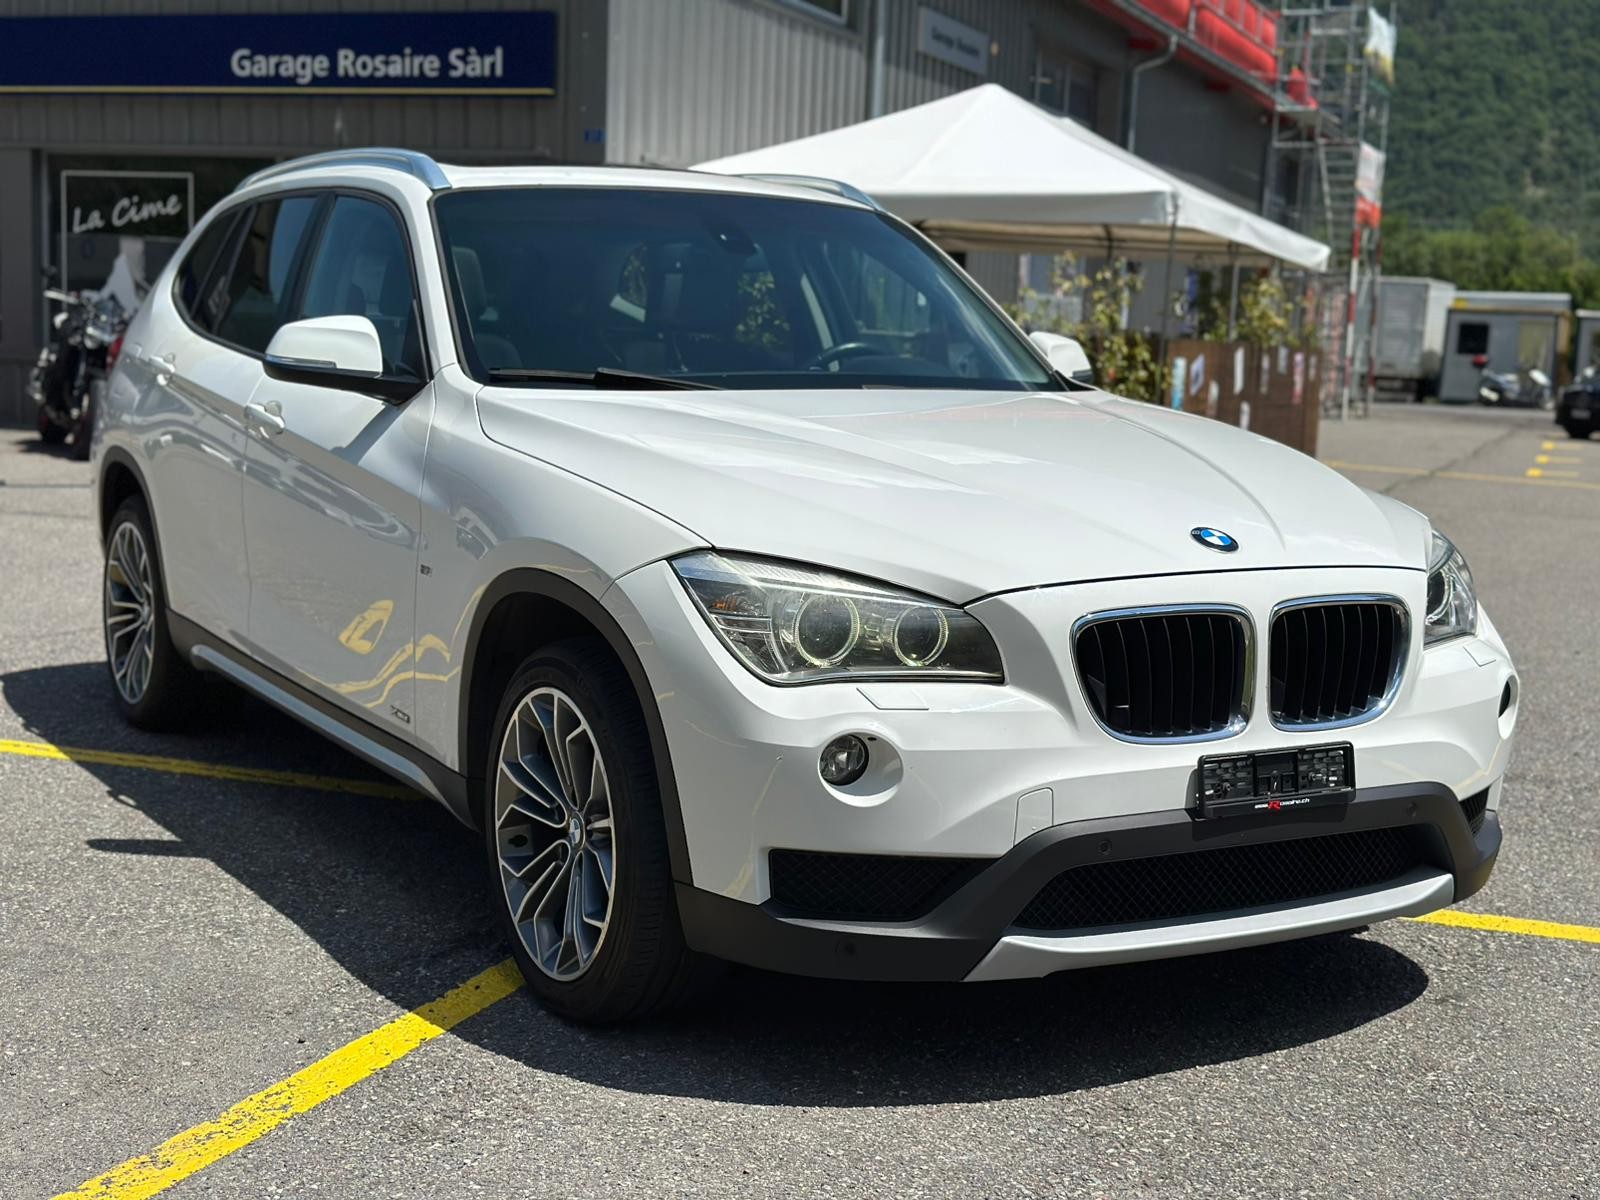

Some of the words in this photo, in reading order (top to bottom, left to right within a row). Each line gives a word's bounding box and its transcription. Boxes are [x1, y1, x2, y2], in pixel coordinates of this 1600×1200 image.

[230, 48, 330, 85] Garage
[337, 47, 441, 78] Rosaire
[448, 45, 504, 78] Sàrl
[72, 206, 105, 234] La
[112, 194, 182, 227] Cime
